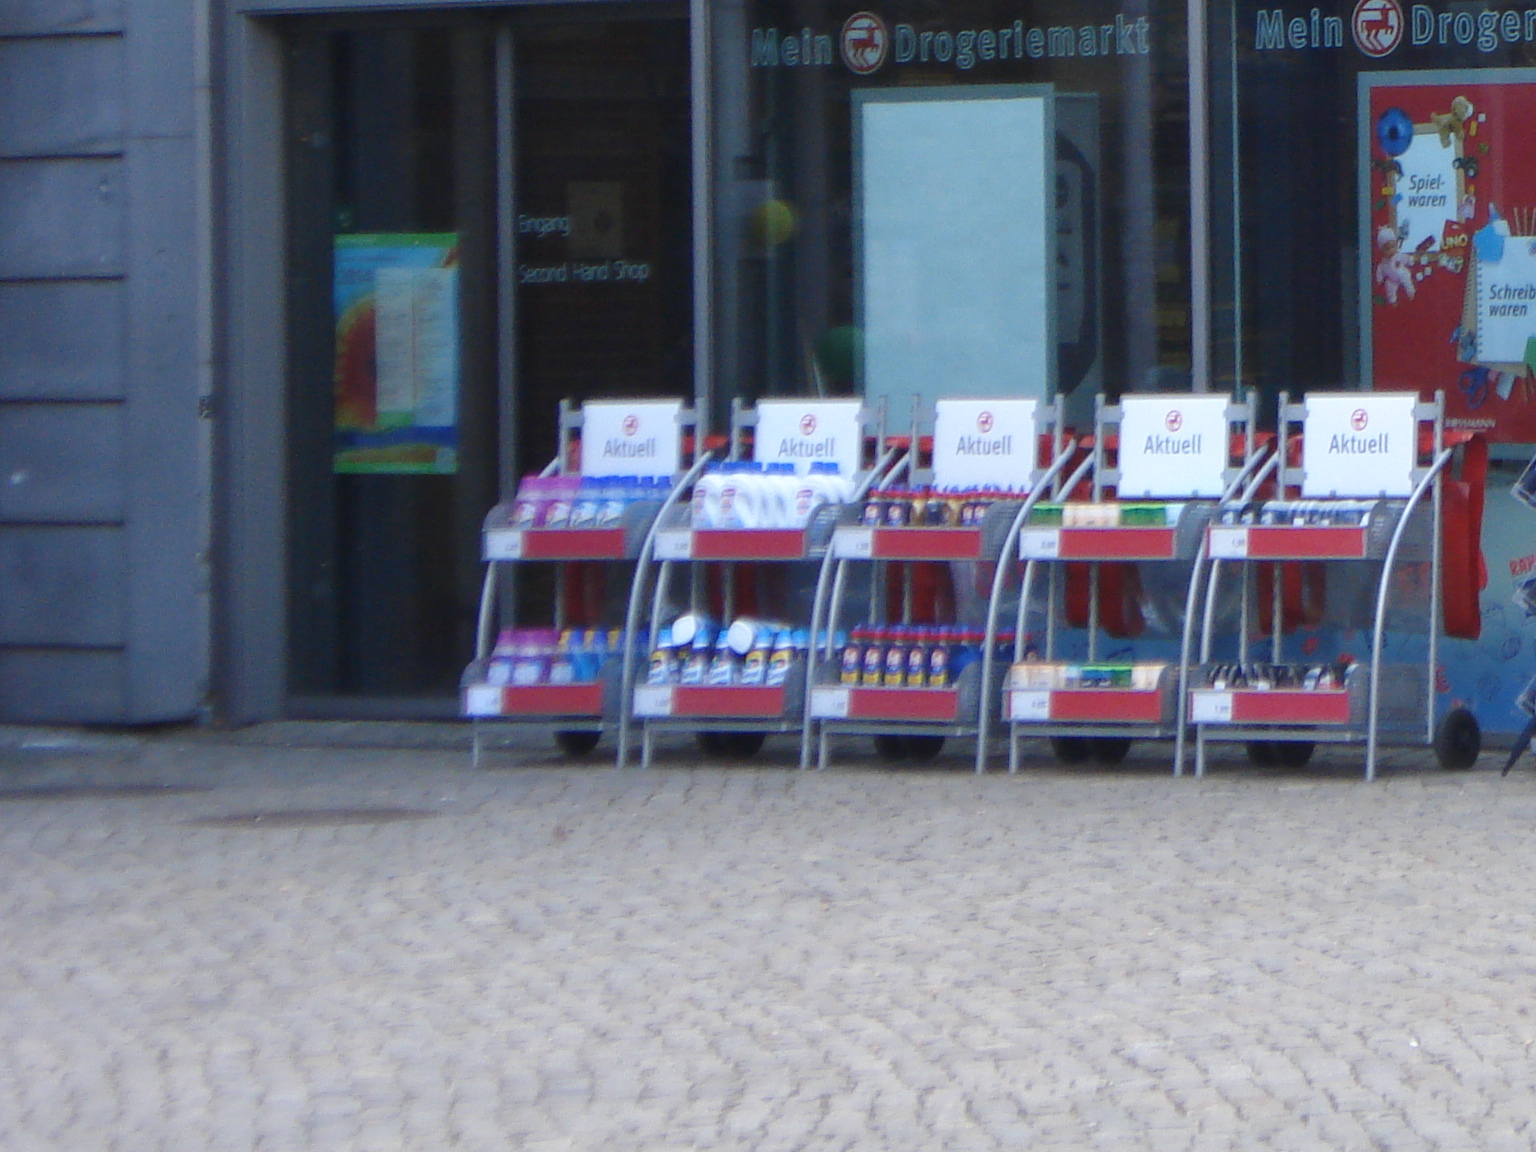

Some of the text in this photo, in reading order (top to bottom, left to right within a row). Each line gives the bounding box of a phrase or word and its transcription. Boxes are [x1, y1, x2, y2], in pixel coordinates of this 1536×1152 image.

[1255, 8, 1343, 51] Mein
[751, 13, 1151, 69] Mein Drogeriemarkt
[1407, 173, 1447, 193] Spiel-
[1407, 193, 1447, 208] waren
[1488, 302, 1528, 318] waren
[603, 439, 656, 458] Aktuell
[778, 438, 835, 458] Aktuell
[956, 434, 1013, 456] Aktuell
[1143, 434, 1202, 456] Aktuell
[1328, 433, 1389, 454] Aktuell
